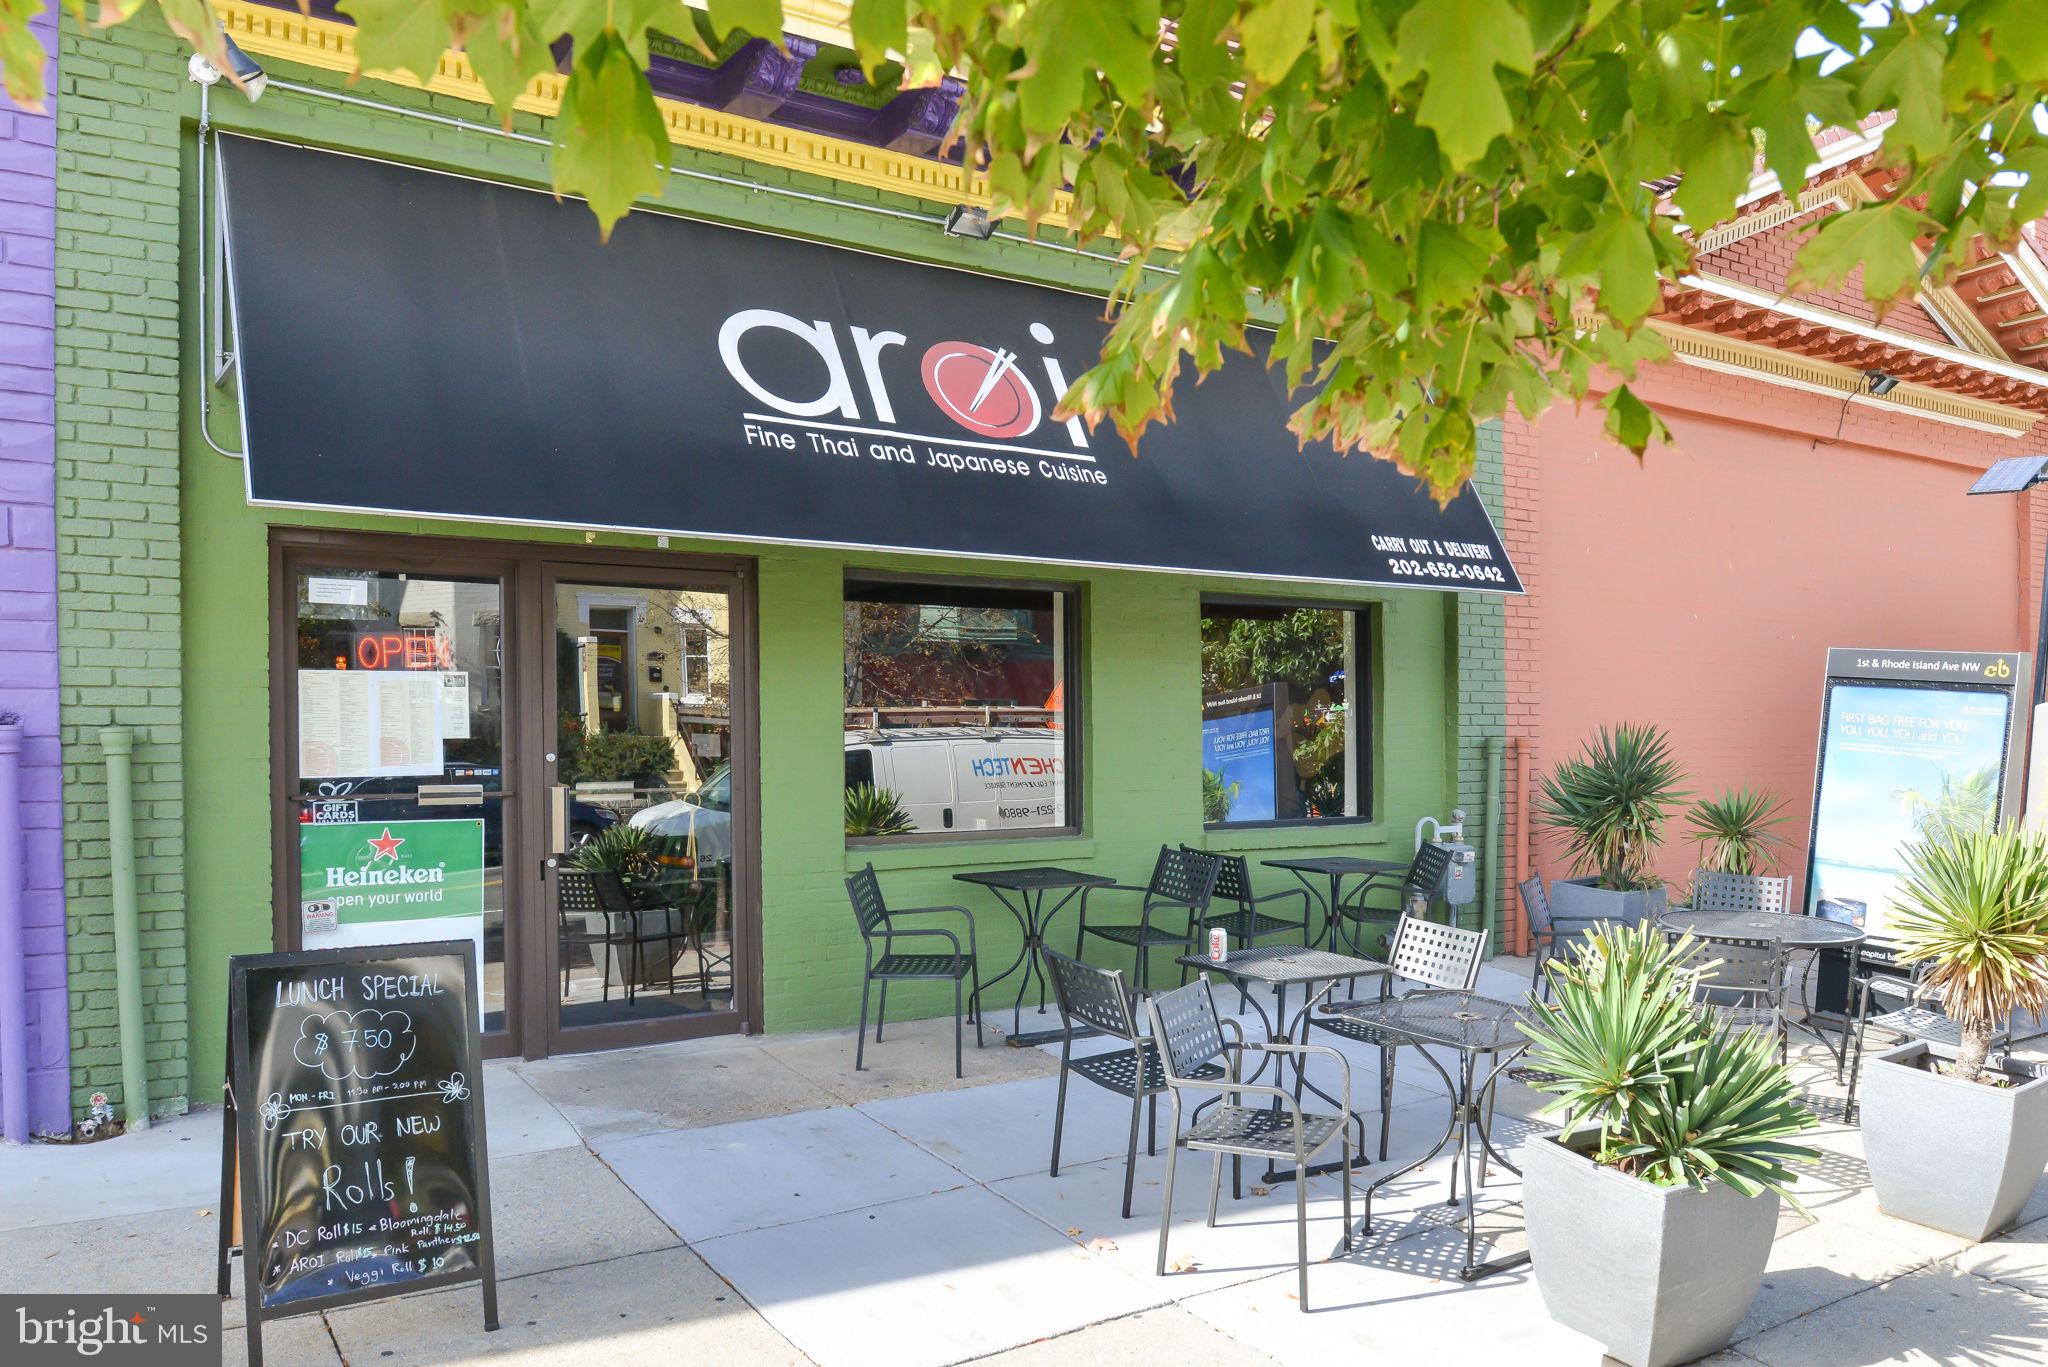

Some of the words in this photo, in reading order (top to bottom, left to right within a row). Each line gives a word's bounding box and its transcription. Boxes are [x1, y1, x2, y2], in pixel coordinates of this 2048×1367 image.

[718, 308, 1090, 448] aroi
[743, 424, 796, 450] Fine
[806, 432, 859, 458] Thai
[869, 441, 917, 465] and
[926, 447, 1031, 474] Japanese
[1038, 460, 1108, 486] Cuisine
[1371, 534, 1407, 554] CARRY
[1409, 538, 1433, 555] OUT
[1433, 540, 1445, 556] &
[1443, 541, 1493, 560] DELIVERY
[1388, 558, 1506, 583] 202-652-0642
[358, 635, 452, 669] OPEN
[1856, 658, 1871, 668] 1st
[1871, 659, 1880, 668] &
[1881, 659, 1911, 669] Rhode
[1912, 660, 1941, 671] Island
[1941, 662, 1960, 671] Ave
[1961, 662, 1981, 672] NW
[1841, 711, 1865, 724] FIRST
[1868, 714, 1889, 726] BAG
[1893, 716, 1915, 728] FREE
[1918, 718, 1939, 730] FOR
[1893, 729, 1916, 740] YOU
[1919, 731, 1938, 743] and
[316, 810, 356, 820] CARDS
[322, 803, 349, 812] GIFT
[368, 895, 400, 908] your
[404, 888, 443, 904] world
[275, 976, 345, 1009] LUNCH
[361, 972, 445, 1001] SPECIAL
[282, 1127, 327, 1151] TRY
[341, 1121, 381, 1146] OUR
[396, 1115, 441, 1138] NEW
[379, 1208, 463, 1232] Bloomingdale
[285, 1229, 310, 1249] DC
[317, 1222, 341, 1242] Roll
[383, 1243, 410, 1256] Pink
[289, 1255, 326, 1275] AROI
[345, 1268, 384, 1286] Veggi
[432, 1256, 445, 1270] 10
